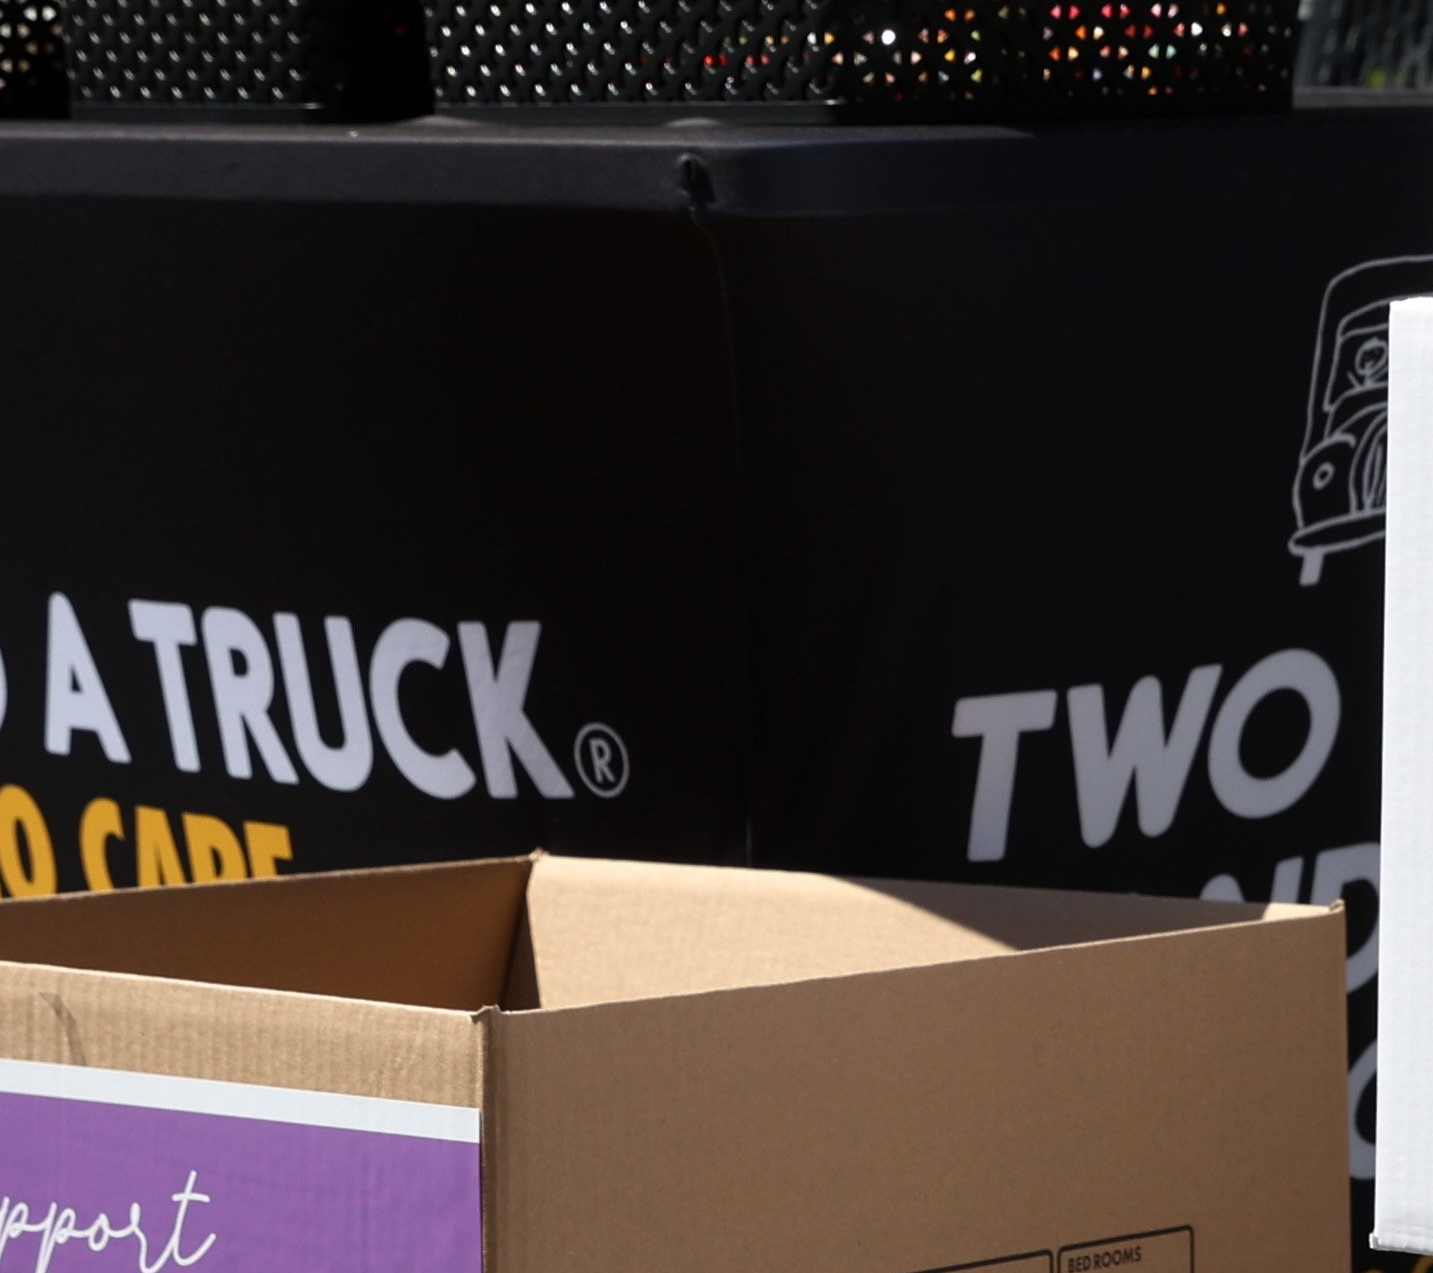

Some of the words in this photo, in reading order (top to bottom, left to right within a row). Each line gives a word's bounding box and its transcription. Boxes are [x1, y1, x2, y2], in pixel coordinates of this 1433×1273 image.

[45, 591, 131, 763] A
[952, 648, 1341, 862] TWO
[1093, 1247, 1142, 1269] ROOMS
